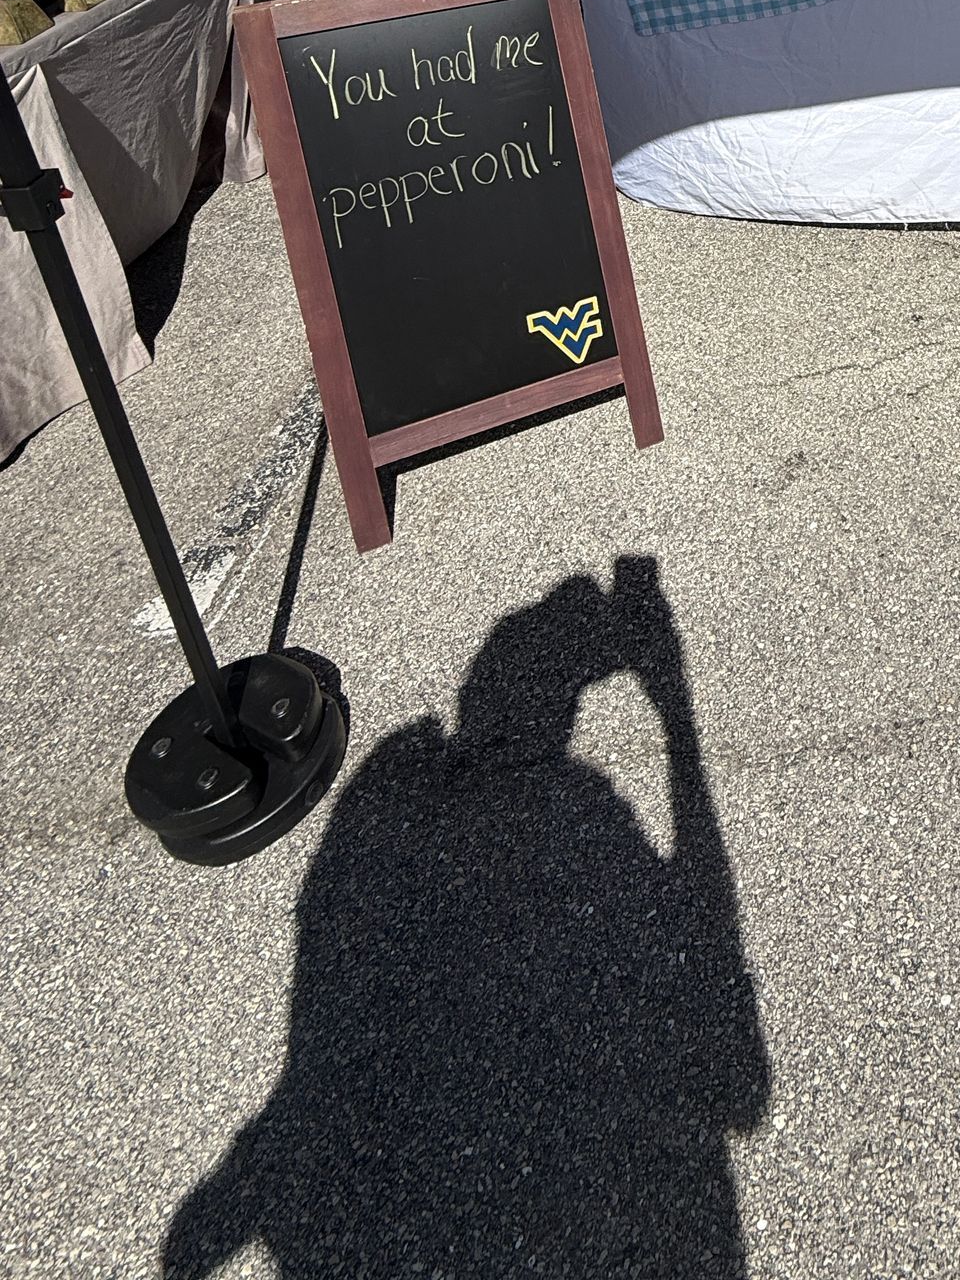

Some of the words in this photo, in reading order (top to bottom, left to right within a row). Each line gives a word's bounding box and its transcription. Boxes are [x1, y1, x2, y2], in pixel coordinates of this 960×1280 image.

[310, 48, 398, 120] You
[412, 26, 477, 91] had
[495, 31, 544, 71] me
[407, 98, 465, 148] at
[326, 106, 562, 249] pepperoni!
